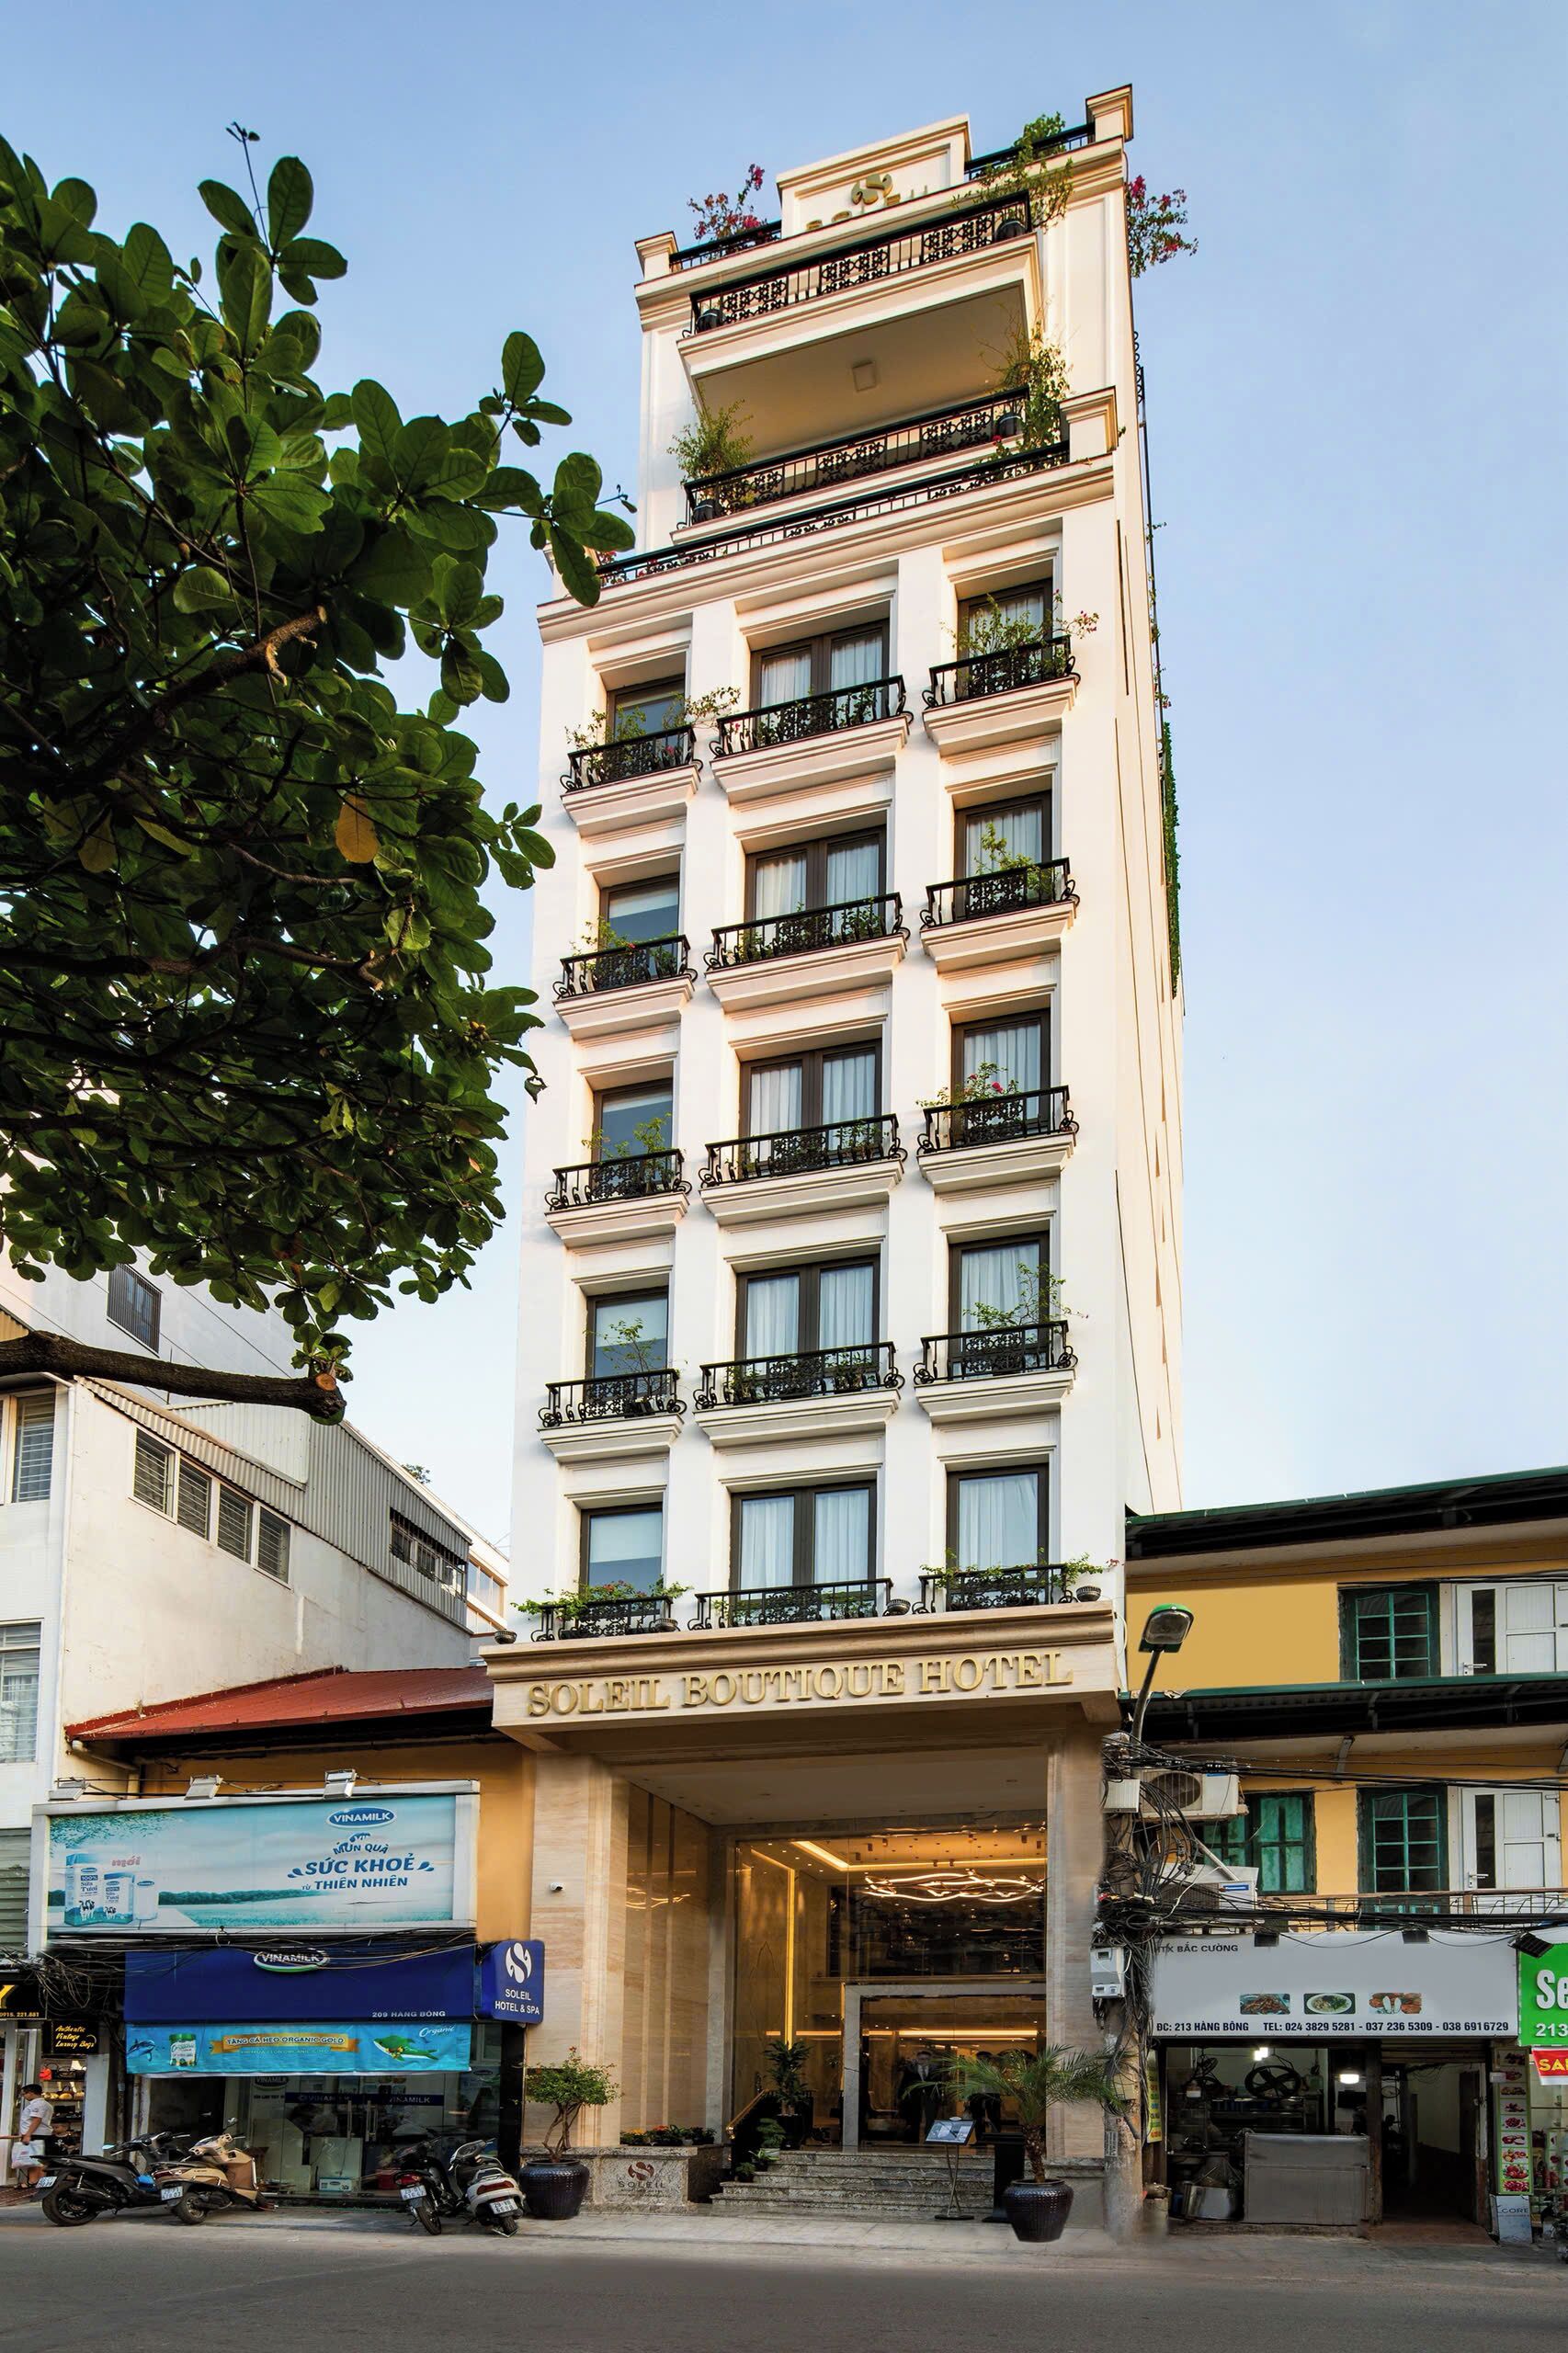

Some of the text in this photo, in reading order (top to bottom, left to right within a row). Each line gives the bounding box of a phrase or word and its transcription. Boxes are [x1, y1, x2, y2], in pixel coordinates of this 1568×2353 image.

[527, 1653, 1074, 1717] SOLEIL BOUTIQUE HOTEL
[333, 1812, 392, 1823] VINAMILK
[365, 1843, 389, 1855] QUÀ
[305, 1853, 415, 1875] SỨC KHOẺ
[314, 1877, 357, 1890] THIÊN
[362, 1875, 408, 1888] NHIÊN
[1176, 1941, 1198, 1952] BẮC
[1200, 1943, 1238, 1952] CƯỜNG
[261, 1953, 321, 1962] VINAMILK
[505, 1988, 531, 2001] SOLEIL
[494, 2001, 540, 2015] HOTEL & SPA
[1175, 2022, 1191, 2031] 213
[1195, 2020, 1221, 2031] HÀNG
[1222, 2020, 1249, 2031] BÔNG
[1263, 2022, 1282, 2031] TEL:
[1285, 2022, 1302, 2031] 024
[1305, 2022, 1329, 2031] 3829
[1332, 2022, 1355, 2031] 5281
[1366, 2022, 1383, 2031] 037
[1386, 2022, 1405, 2031] 236
[1408, 2022, 1433, 2031] 5309
[1442, 2022, 1461, 2031] 038
[1535, 2023, 1568, 2037] 213
[55, 2032, 80, 2041] Vintage
[419, 2025, 455, 2038] Organic
[55, 2040, 77, 2049] Luxury
[249, 2036, 262, 2044] CÁ
